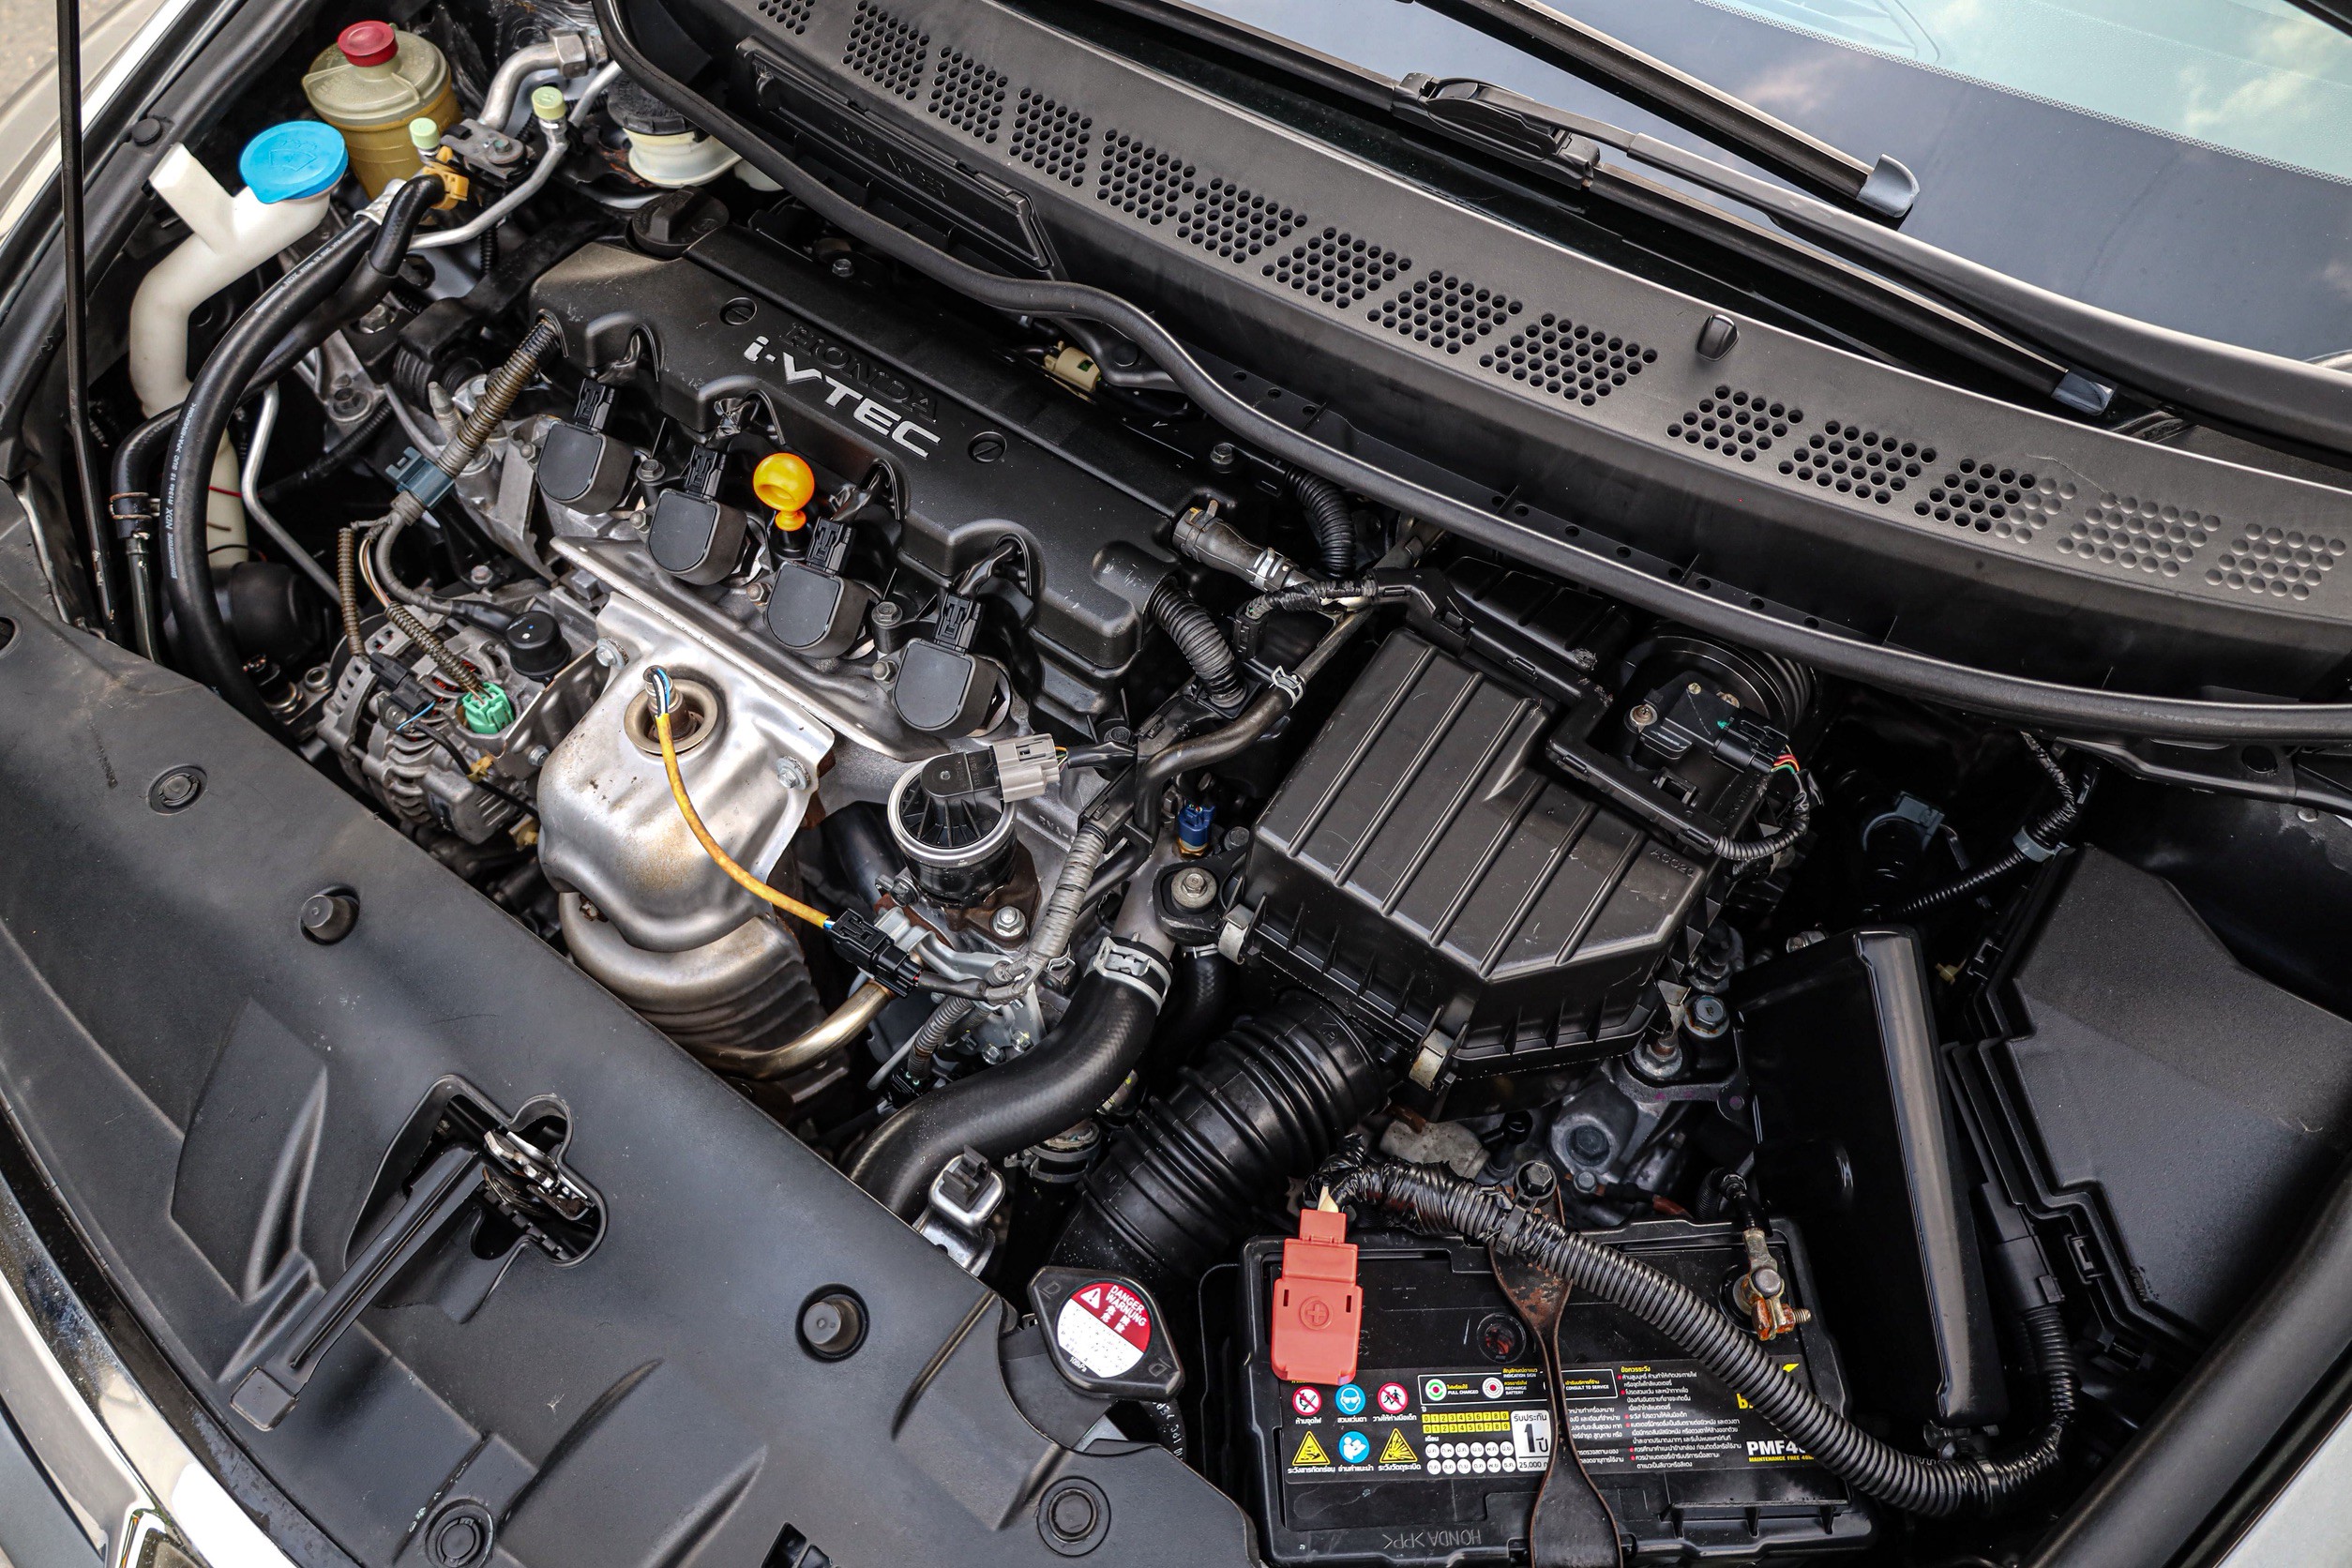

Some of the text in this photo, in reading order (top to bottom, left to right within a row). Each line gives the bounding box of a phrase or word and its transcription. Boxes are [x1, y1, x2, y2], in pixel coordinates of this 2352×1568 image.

[779, 324, 937, 424] HONDA
[744, 335, 942, 460] i-VTEC
[165, 507, 174, 530] NDX
[172, 455, 181, 471] SUC
[1105, 1292, 1147, 1327] WARNUNG
[1110, 1285, 1145, 1313] DANGER
[1514, 1413, 1547, 1422] รับประกัน
[1524, 1423, 1536, 1453] 1
[1427, 1529, 1482, 1547] HONDA
